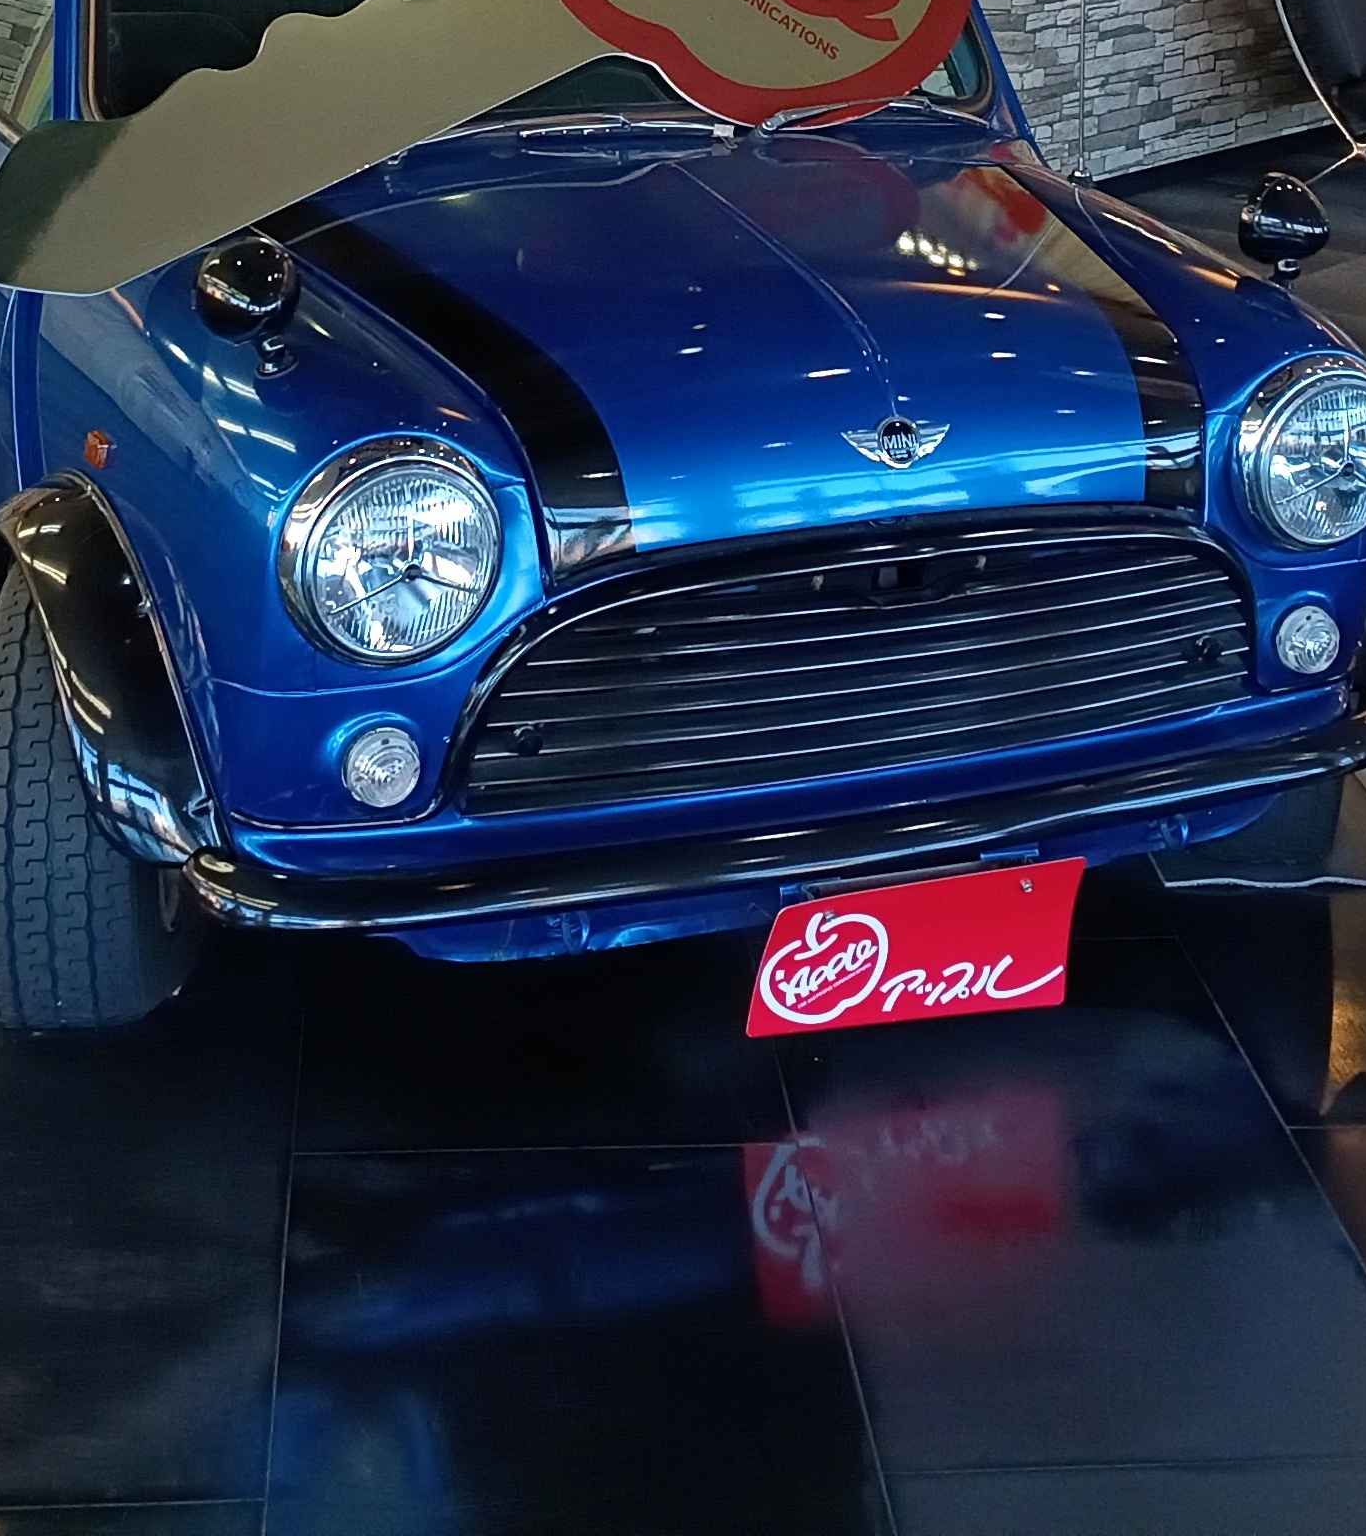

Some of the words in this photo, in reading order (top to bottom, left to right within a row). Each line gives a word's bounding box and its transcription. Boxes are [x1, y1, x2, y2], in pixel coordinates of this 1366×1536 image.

[883, 431, 917, 450] MINI
[881, 955, 1064, 1012] アップル
